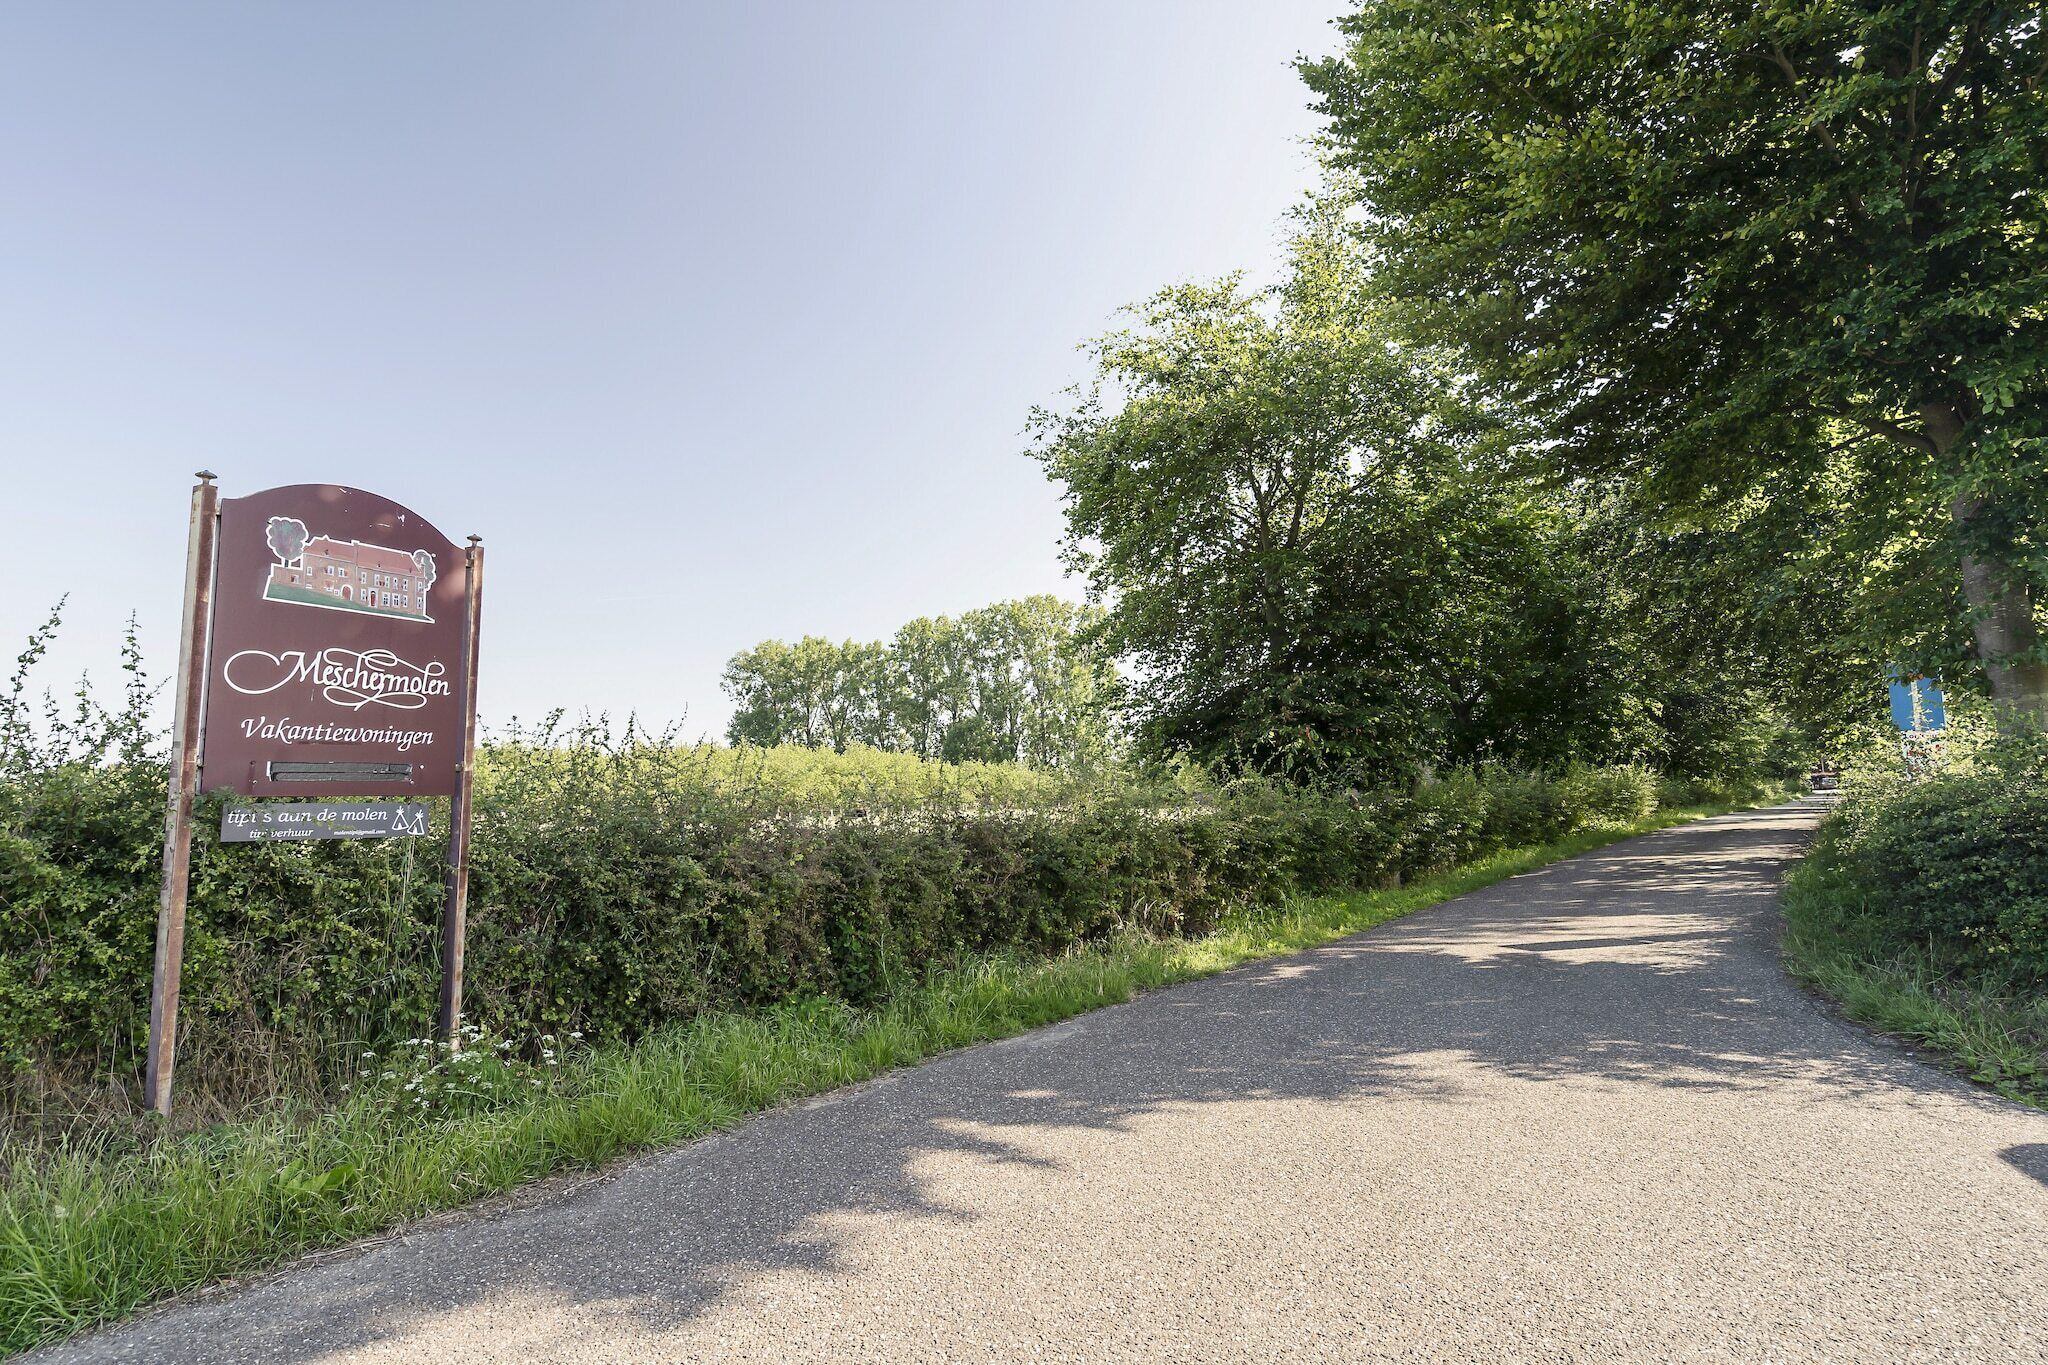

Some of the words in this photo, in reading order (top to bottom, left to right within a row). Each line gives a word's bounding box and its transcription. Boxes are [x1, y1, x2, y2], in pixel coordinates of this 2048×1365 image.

[223, 648, 450, 711] Meschermolen
[240, 716, 433, 751] Vakantiewoningen
[278, 811, 311, 822] aan
[317, 808, 336, 821] de
[342, 808, 388, 821] molen
[271, 828, 314, 838] verhuur
